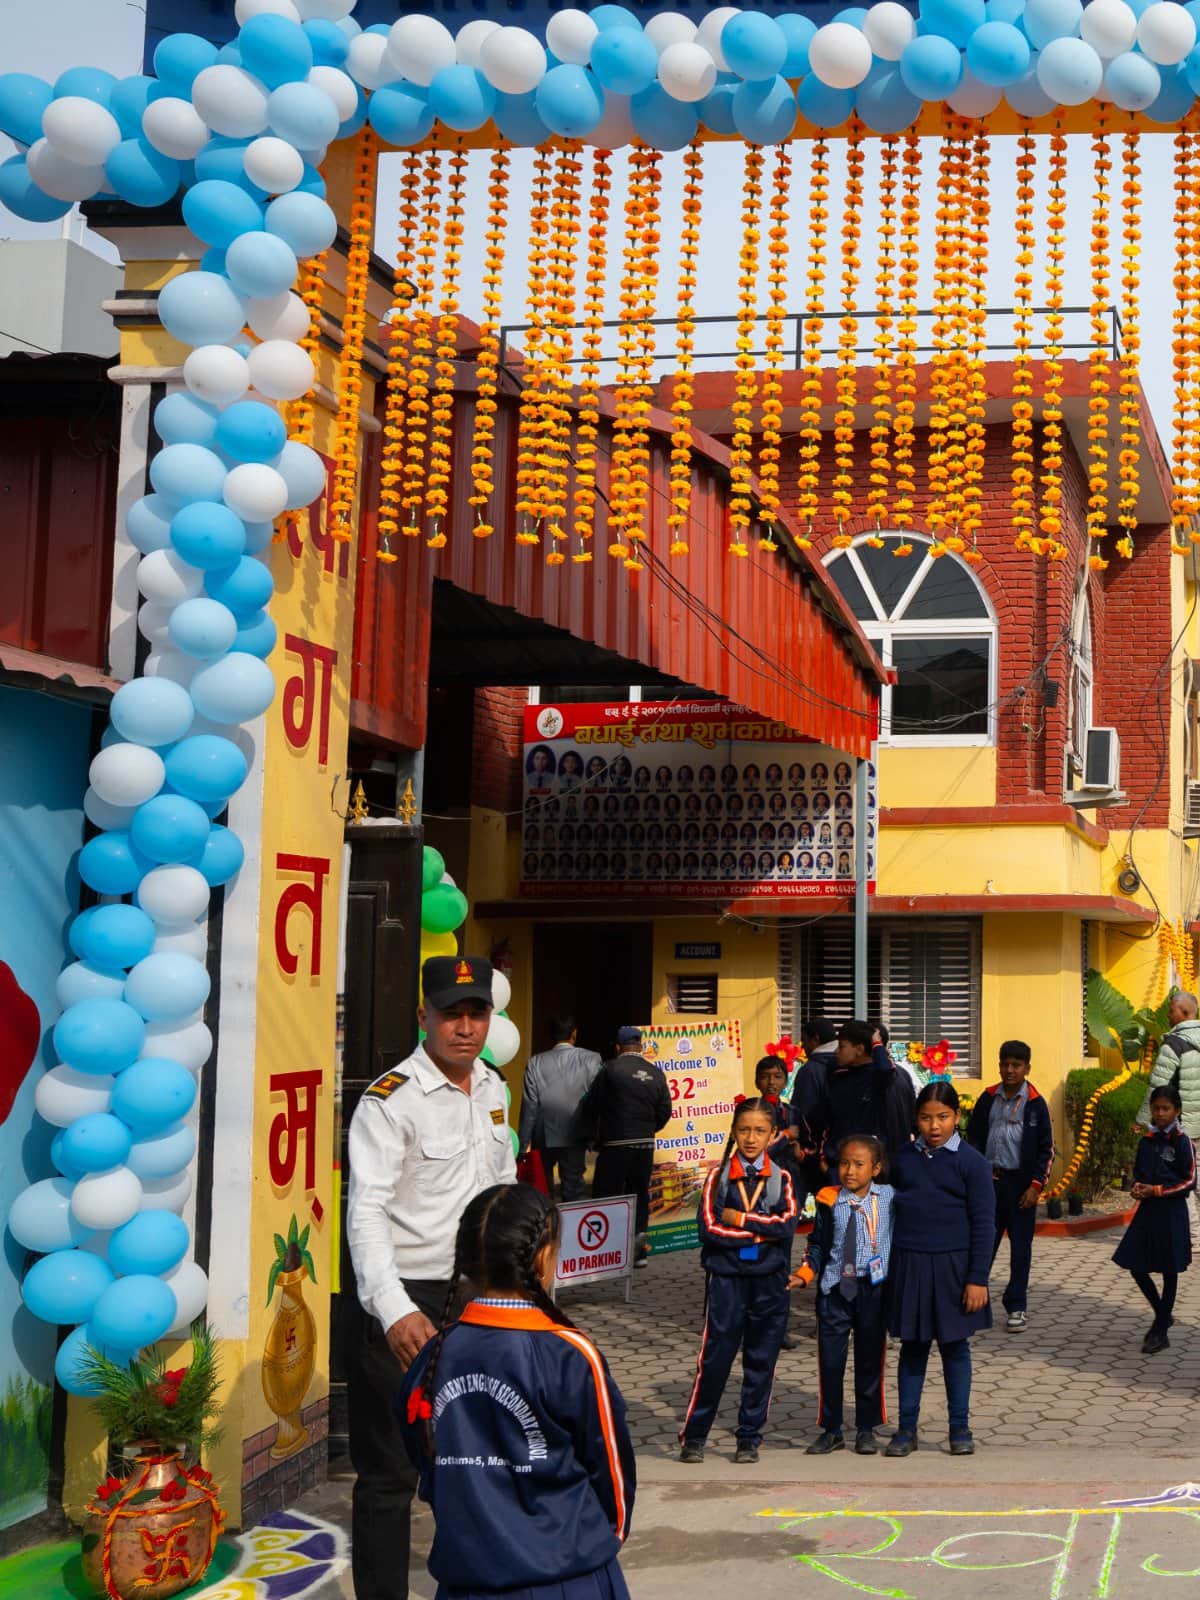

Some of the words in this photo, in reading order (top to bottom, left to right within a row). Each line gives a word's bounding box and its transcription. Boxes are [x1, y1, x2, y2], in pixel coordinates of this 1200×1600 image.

[574, 717, 637, 748] बधाई
[640, 722, 687, 743] तथा
[654, 1058, 702, 1073] Welcome
[705, 1056, 717, 1068] To
[686, 1121, 695, 1132] &
[704, 1132, 725, 1145] Day
[677, 1148, 706, 1162] 2082
[562, 1258, 577, 1273] NO
[578, 1251, 622, 1270] PARKING
[495, 1383, 540, 1430] SECONDARY
